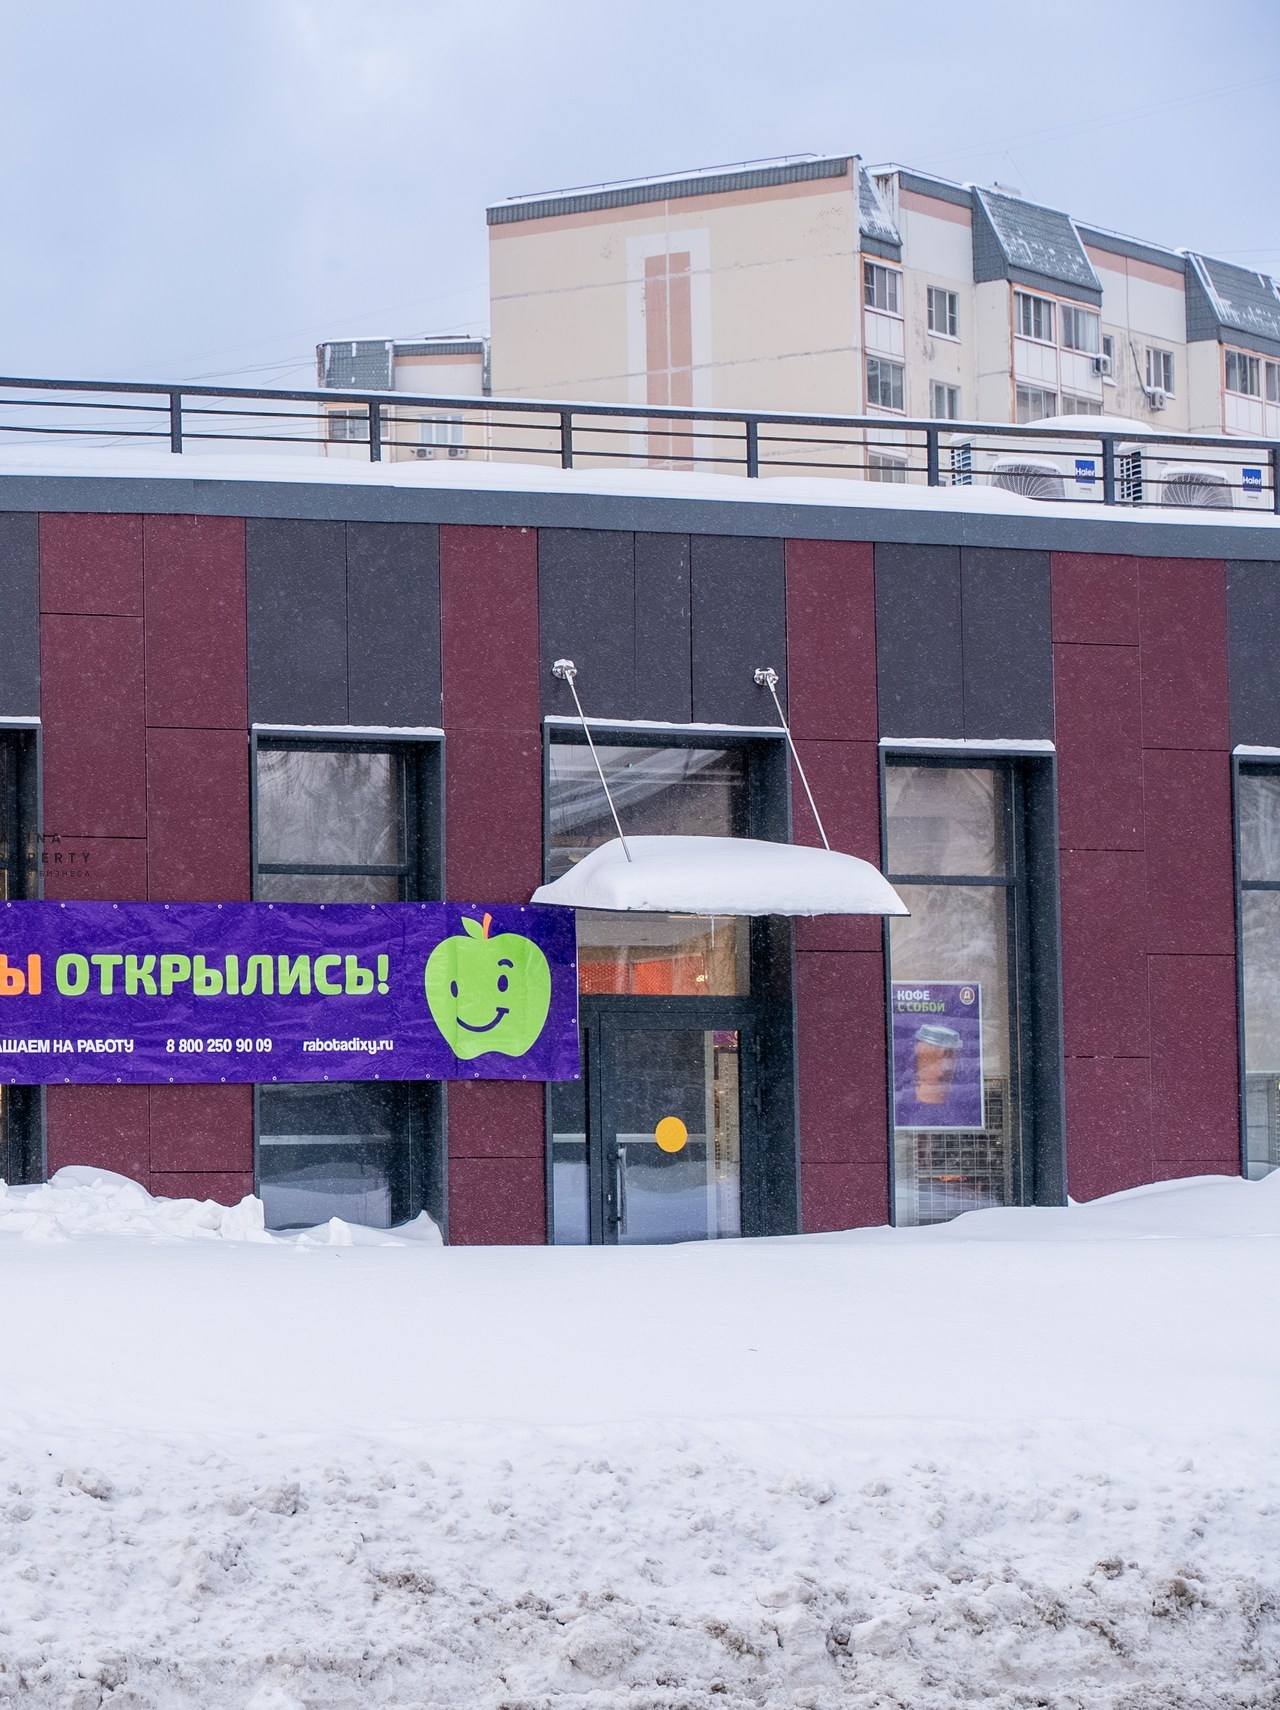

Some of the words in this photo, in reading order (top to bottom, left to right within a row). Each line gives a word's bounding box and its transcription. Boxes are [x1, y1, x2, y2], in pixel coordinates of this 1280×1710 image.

[1075, 467, 1095, 477] Haier
[1242, 476, 1262, 485] Haier
[55, 953, 390, 996] ОТКРЫЛИСЬ!
[897, 990, 930, 1000] КОФЕ
[898, 1001, 905, 1012] С
[906, 1000, 945, 1012] СОБОЙ
[53, 1039, 74, 1053] НА
[77, 1039, 134, 1053] РАБОТУ
[165, 1038, 175, 1053] 8
[179, 1038, 203, 1053] 800
[207, 1038, 232, 1053] 250
[235, 1038, 253, 1053] 90
[255, 1038, 272, 1053] 09
[302, 1037, 394, 1054] rabotadixy.ru
